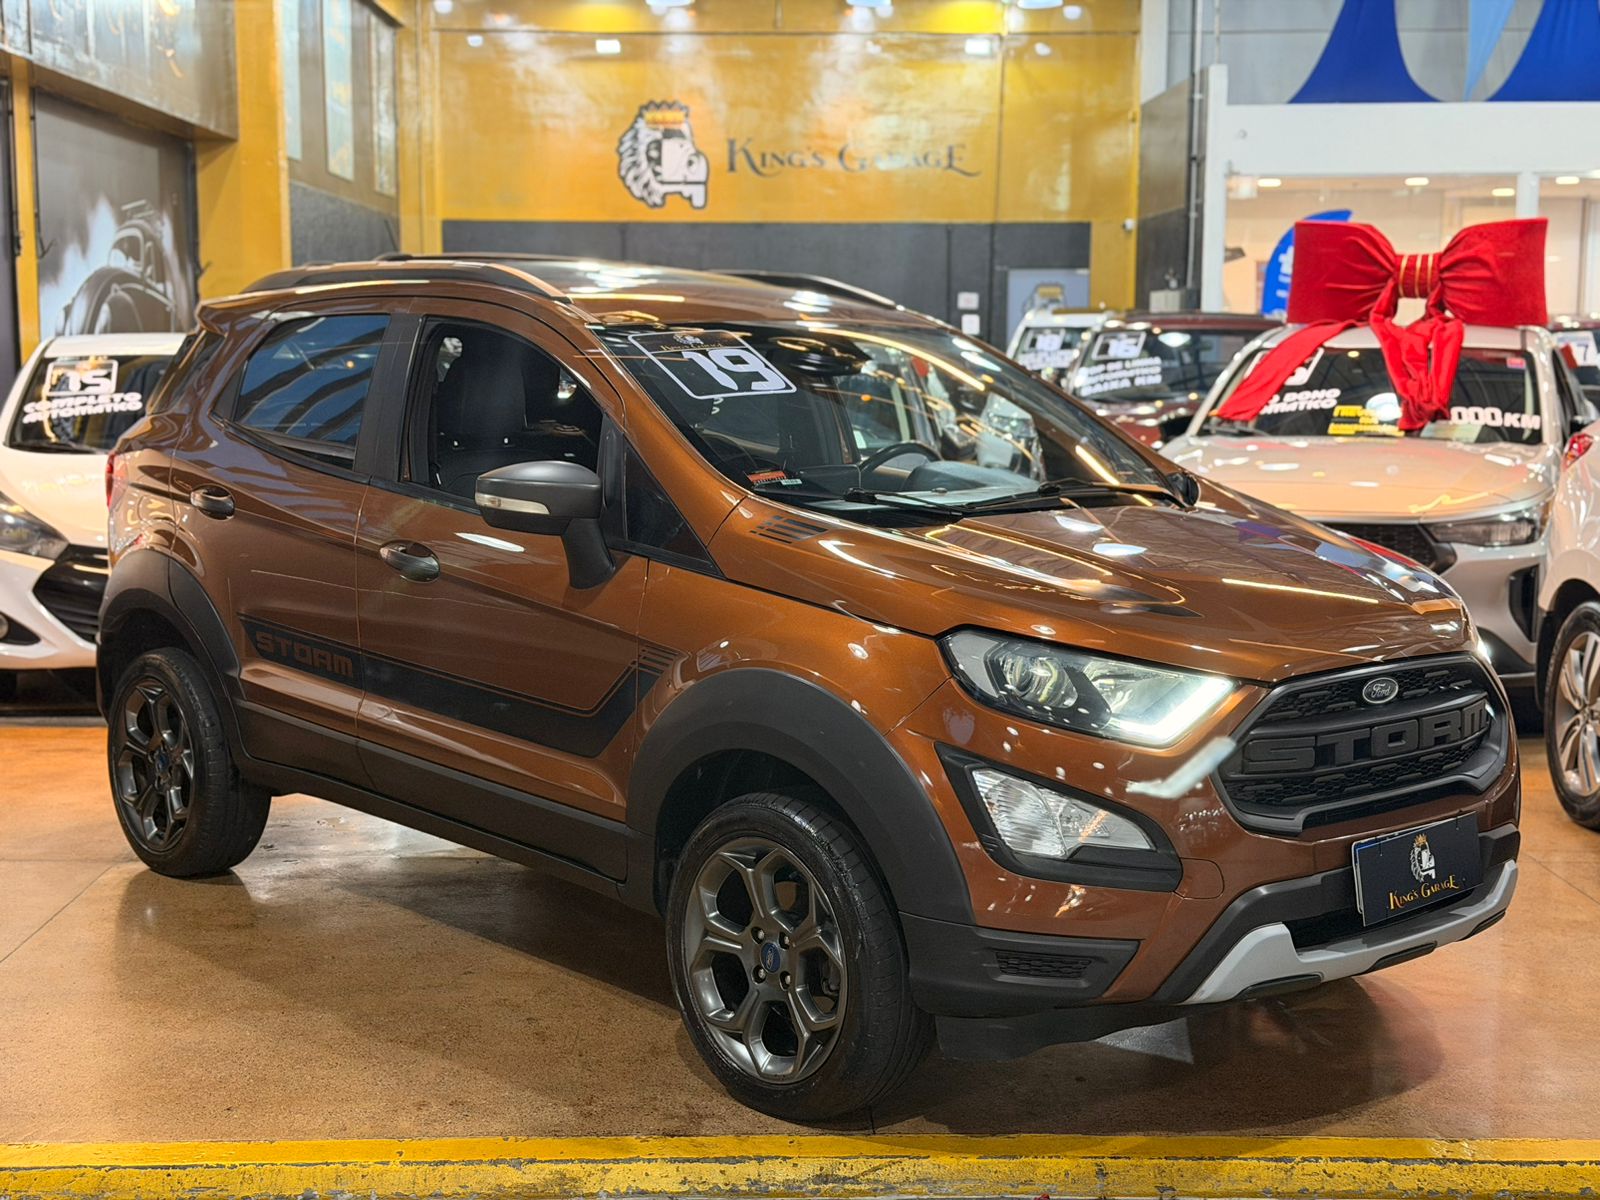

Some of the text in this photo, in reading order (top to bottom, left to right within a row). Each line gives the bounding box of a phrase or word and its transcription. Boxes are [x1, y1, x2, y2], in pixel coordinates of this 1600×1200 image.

[838, 143, 982, 177] GAGE
[683, 349, 786, 391] 19
[23, 392, 142, 414] COMPLETO
[1503, 412, 1541, 430] KM
[256, 631, 354, 678] STORM
[1243, 700, 1488, 774] STORM
